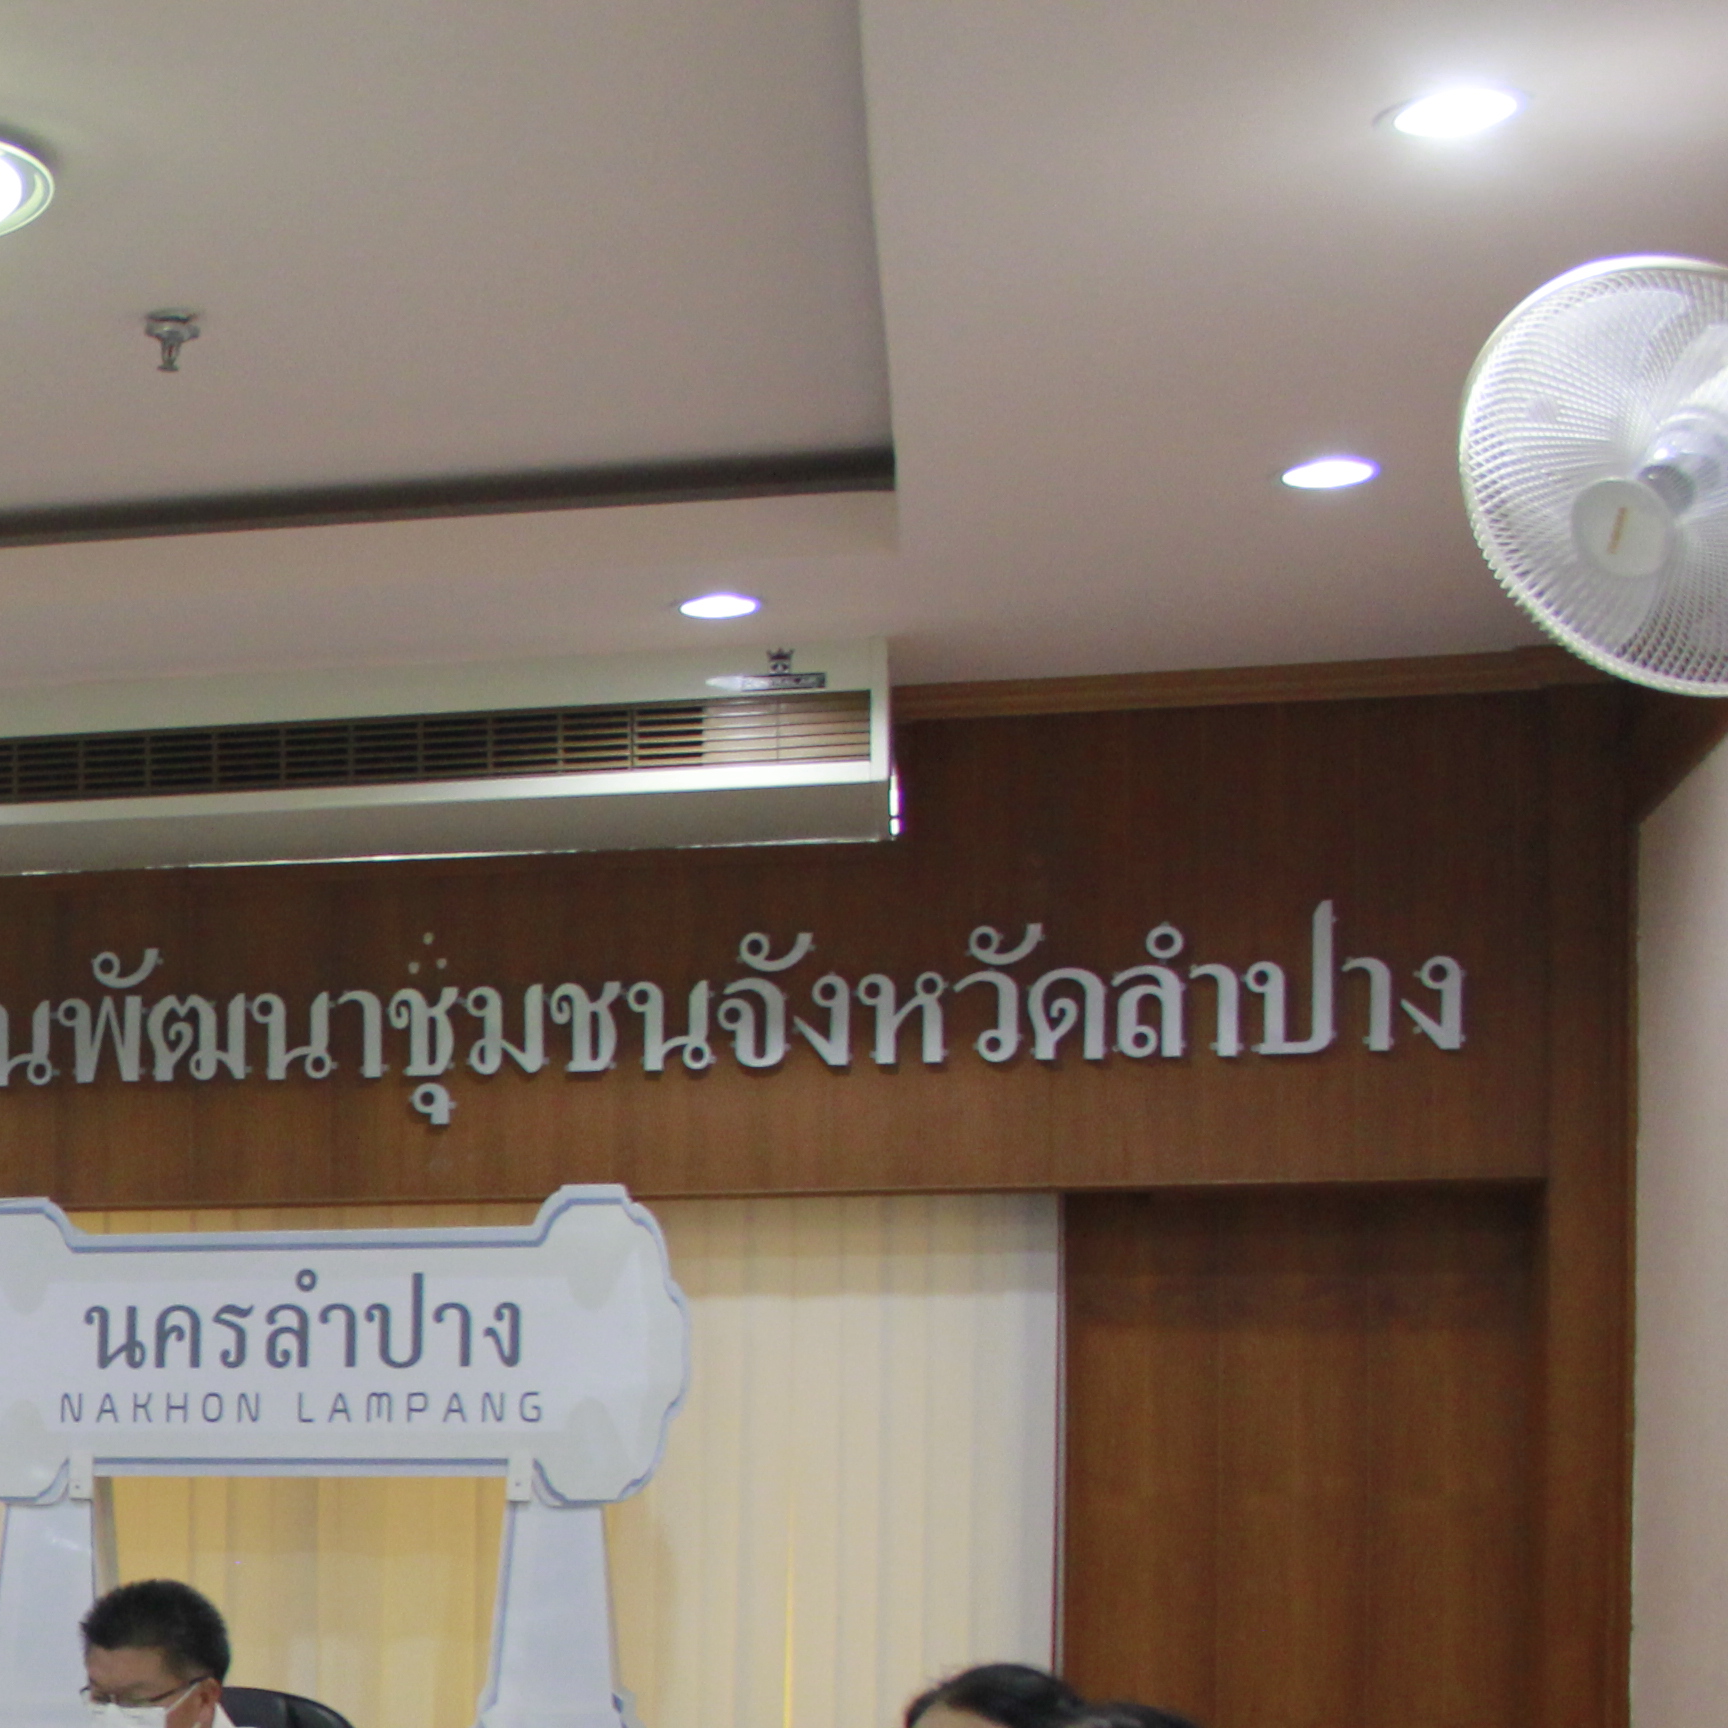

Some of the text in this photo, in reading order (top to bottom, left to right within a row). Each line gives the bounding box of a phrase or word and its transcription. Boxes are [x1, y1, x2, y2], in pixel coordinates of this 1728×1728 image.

[84, 1269, 521, 1370] นครลำปาง
[59, 1390, 543, 1424] NAKHON LAMPANG
